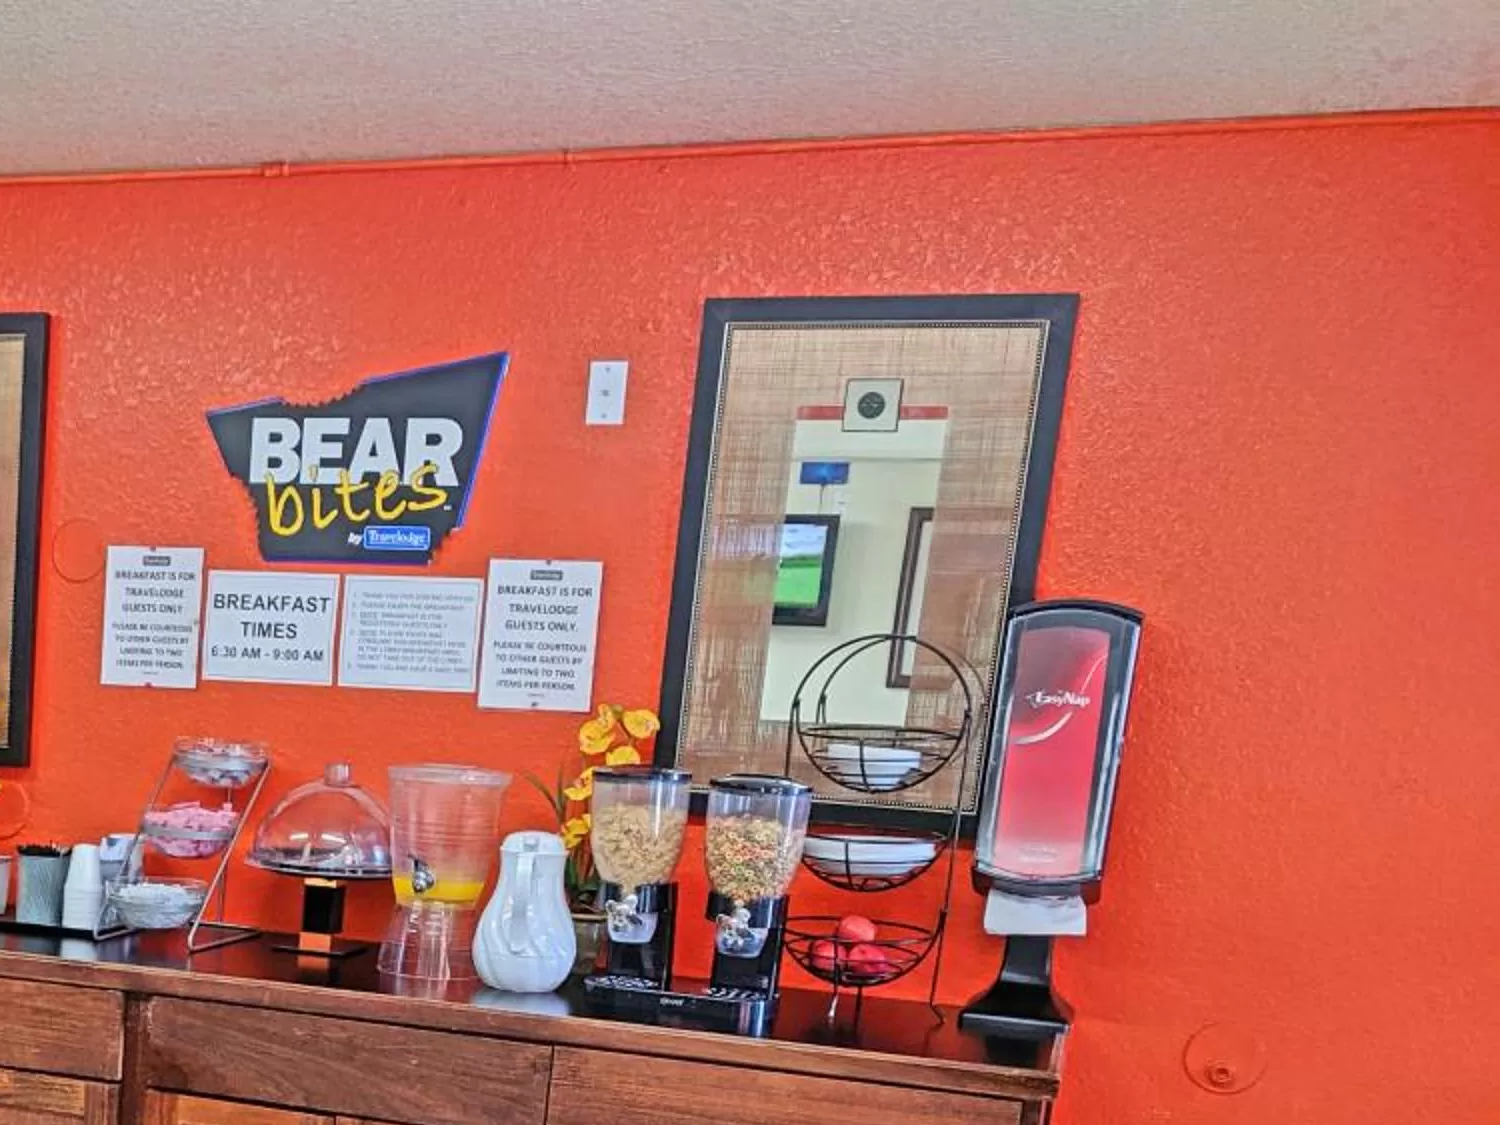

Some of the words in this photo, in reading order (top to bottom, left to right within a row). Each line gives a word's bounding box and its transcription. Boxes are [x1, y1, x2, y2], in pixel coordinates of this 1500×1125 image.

[249, 417, 463, 487] BEAR
[265, 463, 449, 536] bites
[348, 531, 362, 545] by
[367, 529, 427, 546] Travelodge
[497, 585, 557, 597] BREAKFAST
[559, 587, 569, 597] IS
[571, 587, 593, 597] FOR
[213, 593, 331, 613] BREAKFAST
[508, 603, 578, 615] TRAVELODGE
[240, 621, 298, 640] TIMES
[505, 620, 545, 631] GUESTS
[241, 647, 261, 659] AM
[273, 649, 299, 661] 9:00
[303, 650, 324, 661] AM
[1035, 689, 1091, 707] EasyNap
